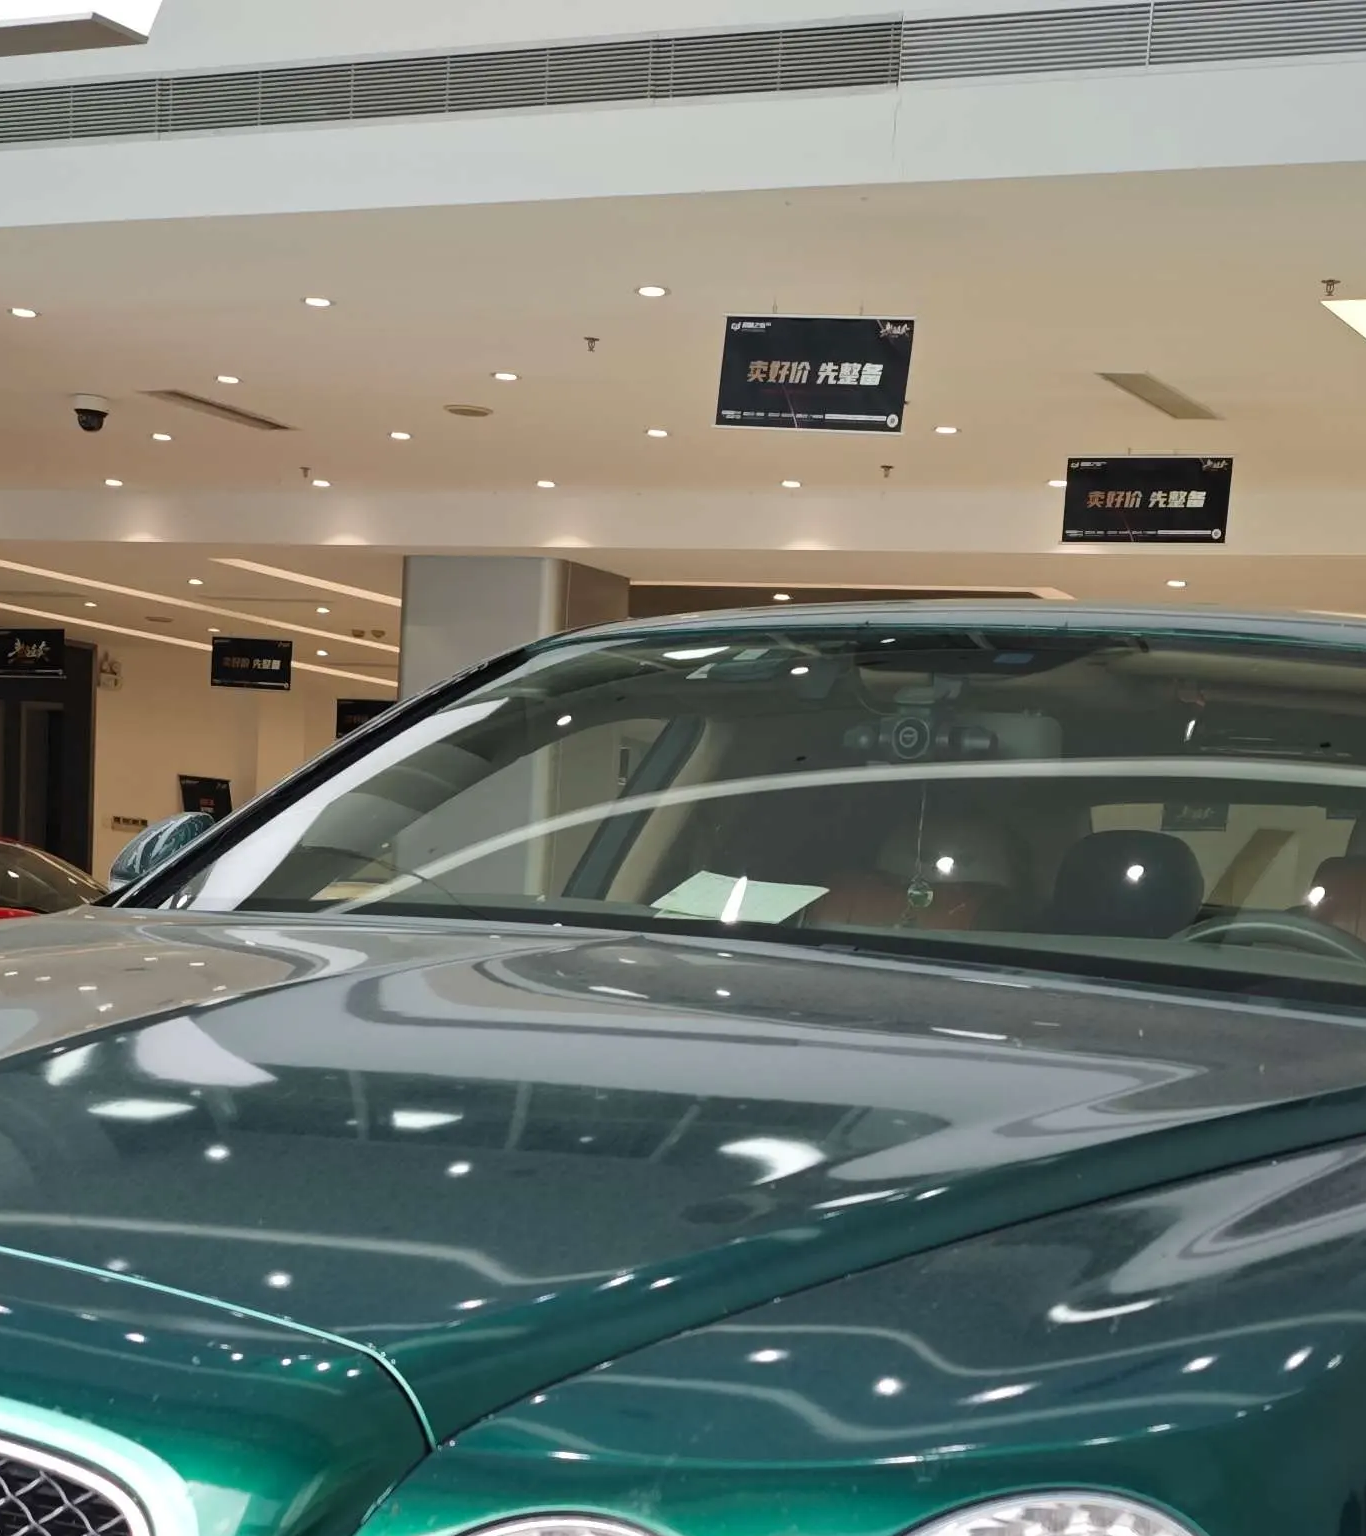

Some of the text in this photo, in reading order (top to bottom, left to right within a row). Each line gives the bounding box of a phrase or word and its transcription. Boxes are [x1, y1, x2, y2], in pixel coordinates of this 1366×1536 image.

[747, 361, 884, 386] 卖好价 先整备
